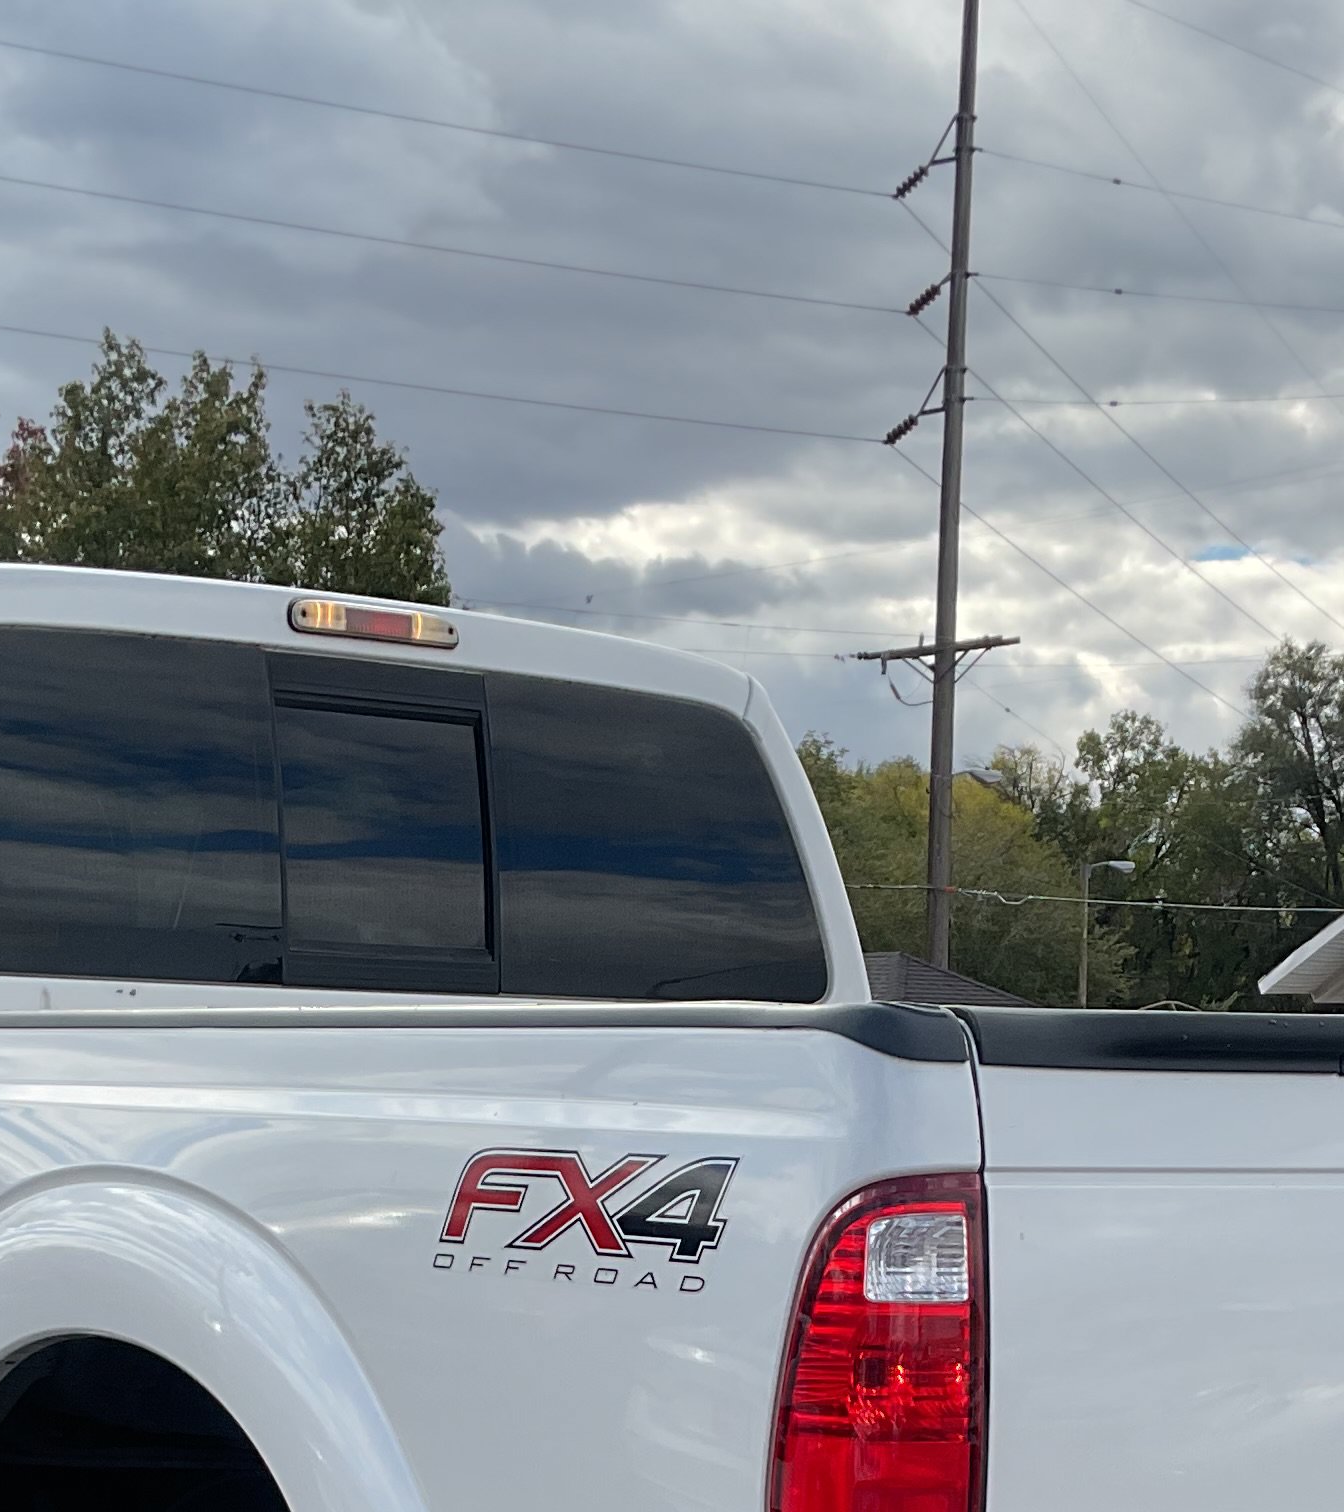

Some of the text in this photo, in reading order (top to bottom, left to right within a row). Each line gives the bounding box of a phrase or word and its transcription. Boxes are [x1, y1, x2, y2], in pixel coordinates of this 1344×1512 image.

[439, 1147, 741, 1264] FX4
[432, 1253, 706, 1293] OFF ROAD
